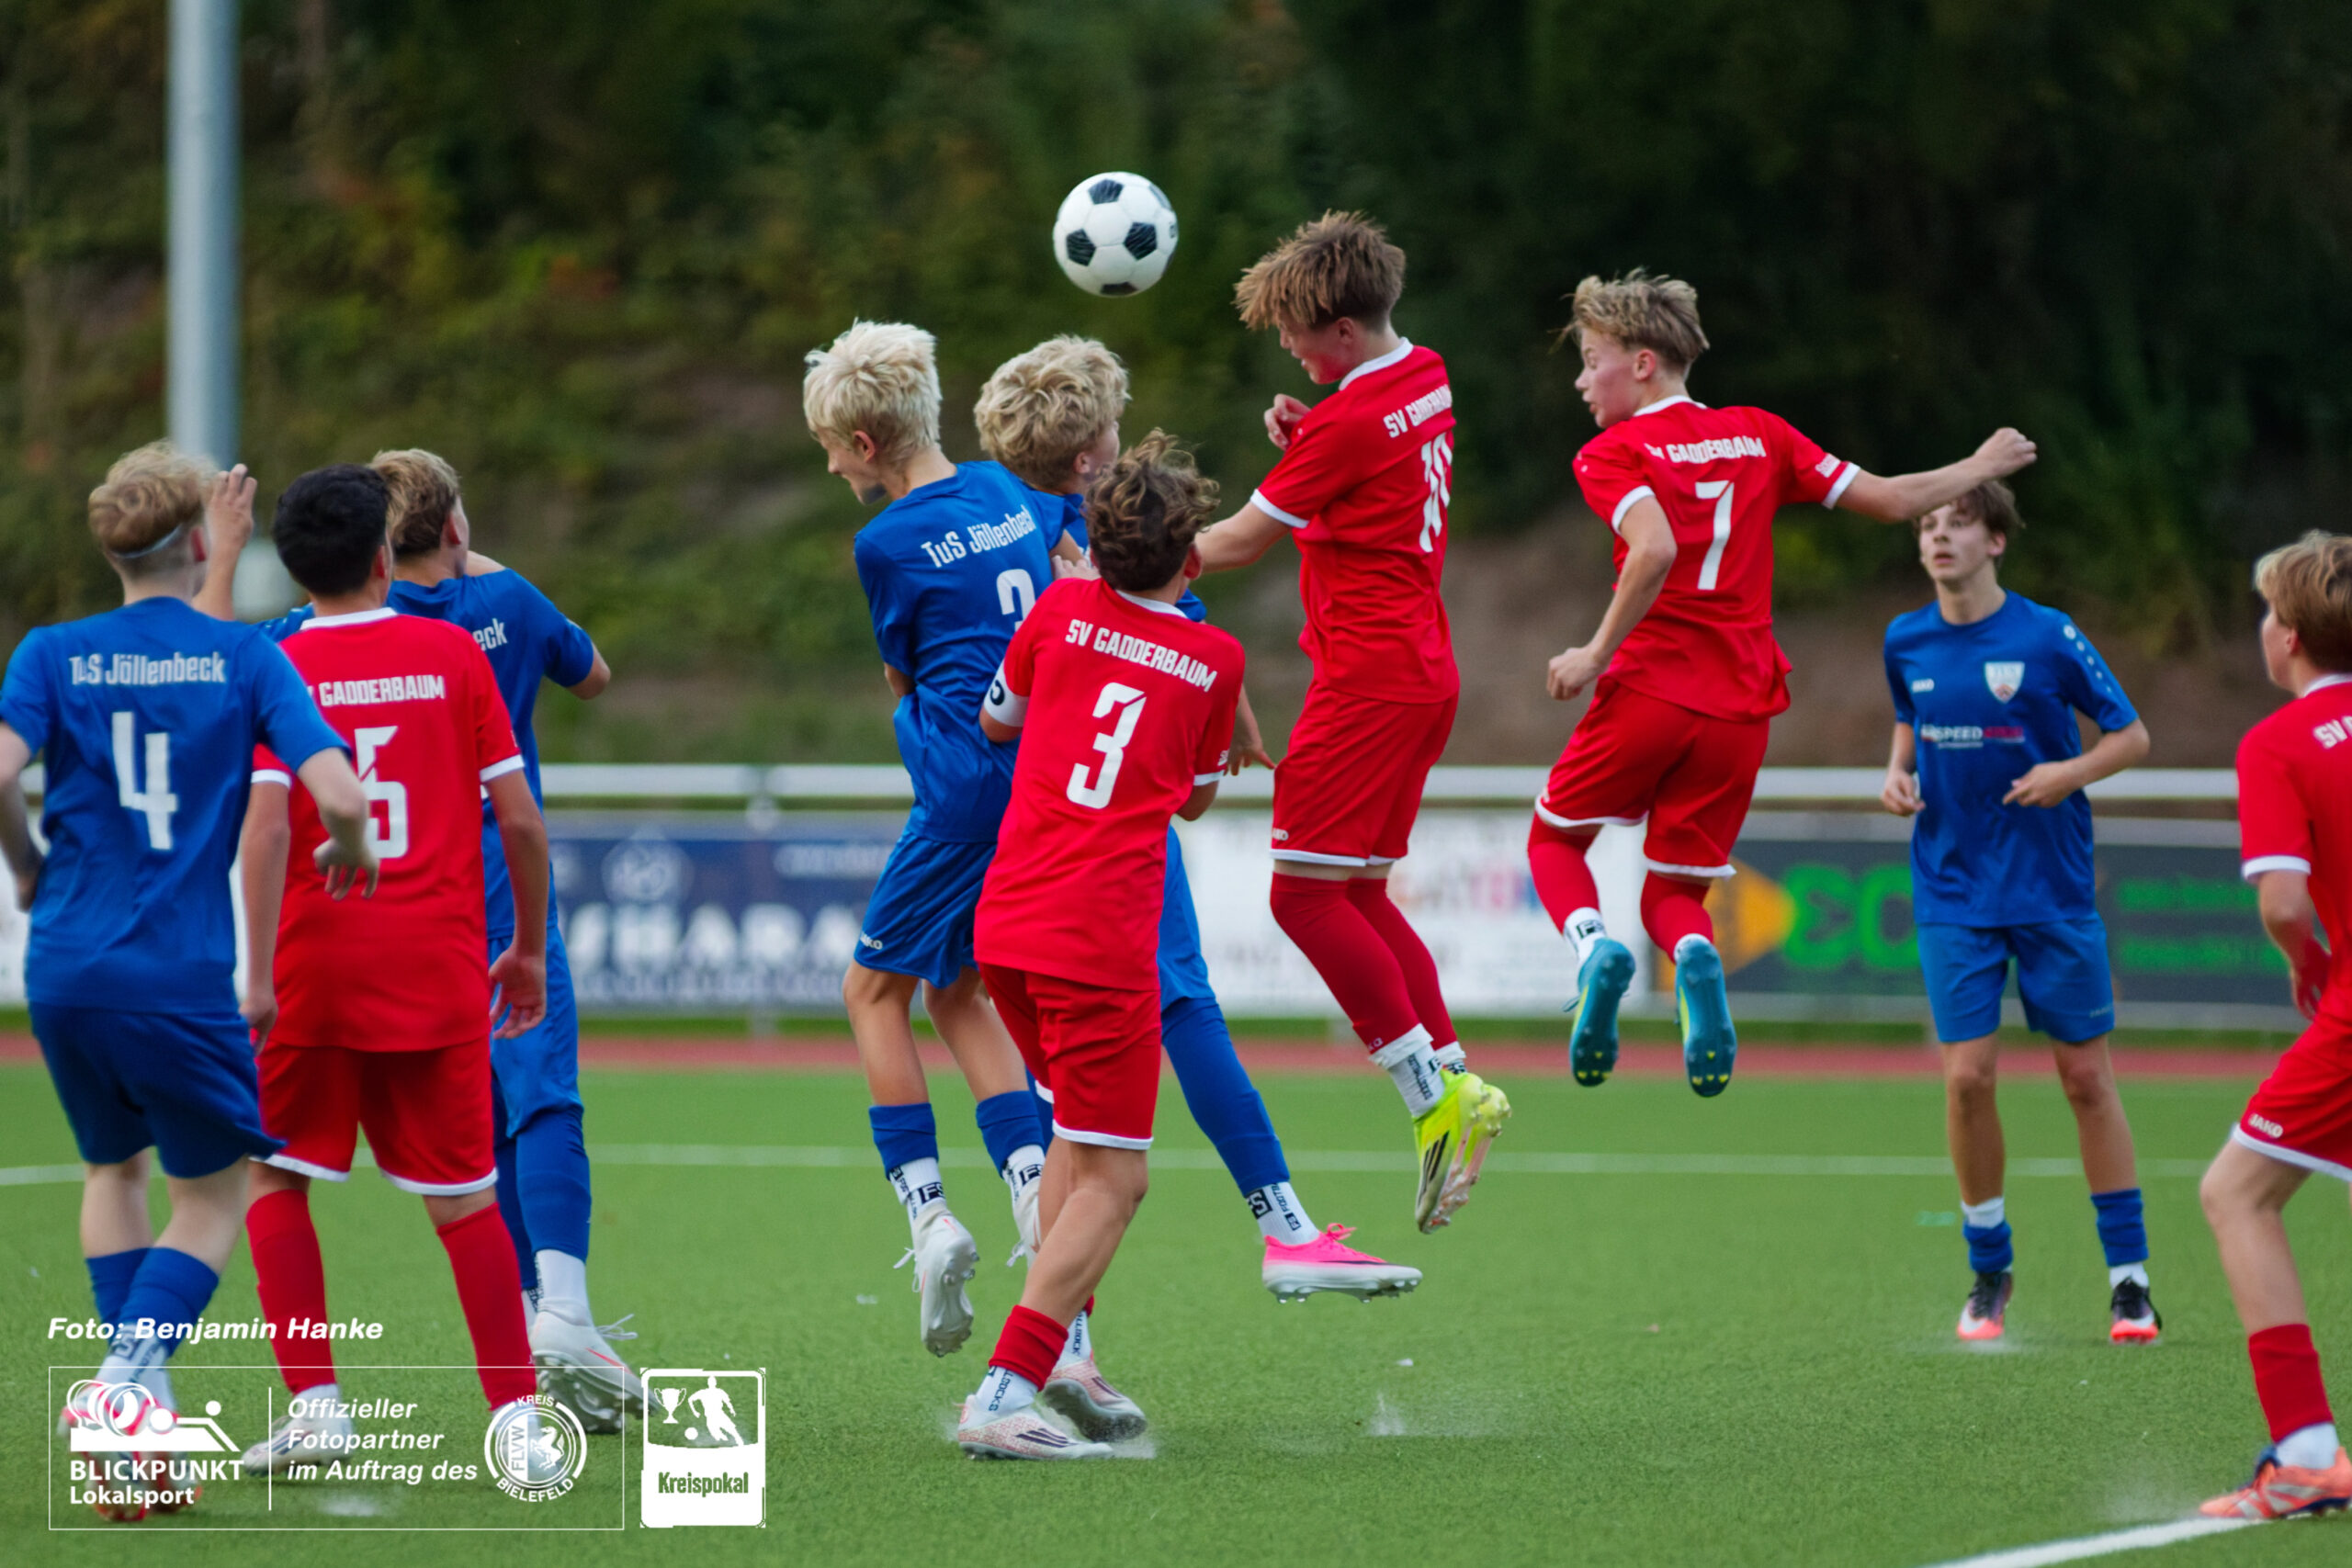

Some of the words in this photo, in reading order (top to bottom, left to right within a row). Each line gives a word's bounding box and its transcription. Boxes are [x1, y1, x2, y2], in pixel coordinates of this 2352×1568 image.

[1383, 410, 1408, 438] SV
[921, 531, 967, 568] TuS
[1695, 479, 1735, 591] 7
[105, 651, 226, 685] Jöllenbeck
[1066, 618, 1093, 647] SV
[1093, 626, 1217, 693] GADDERBAUM
[318, 674, 447, 707] GADDERBAUM
[1067, 682, 1147, 810] 3
[2312, 718, 2348, 750] SV
[111, 711, 180, 850] 4
[354, 726, 409, 858] 5
[2248, 1112, 2284, 1138] JAKO
